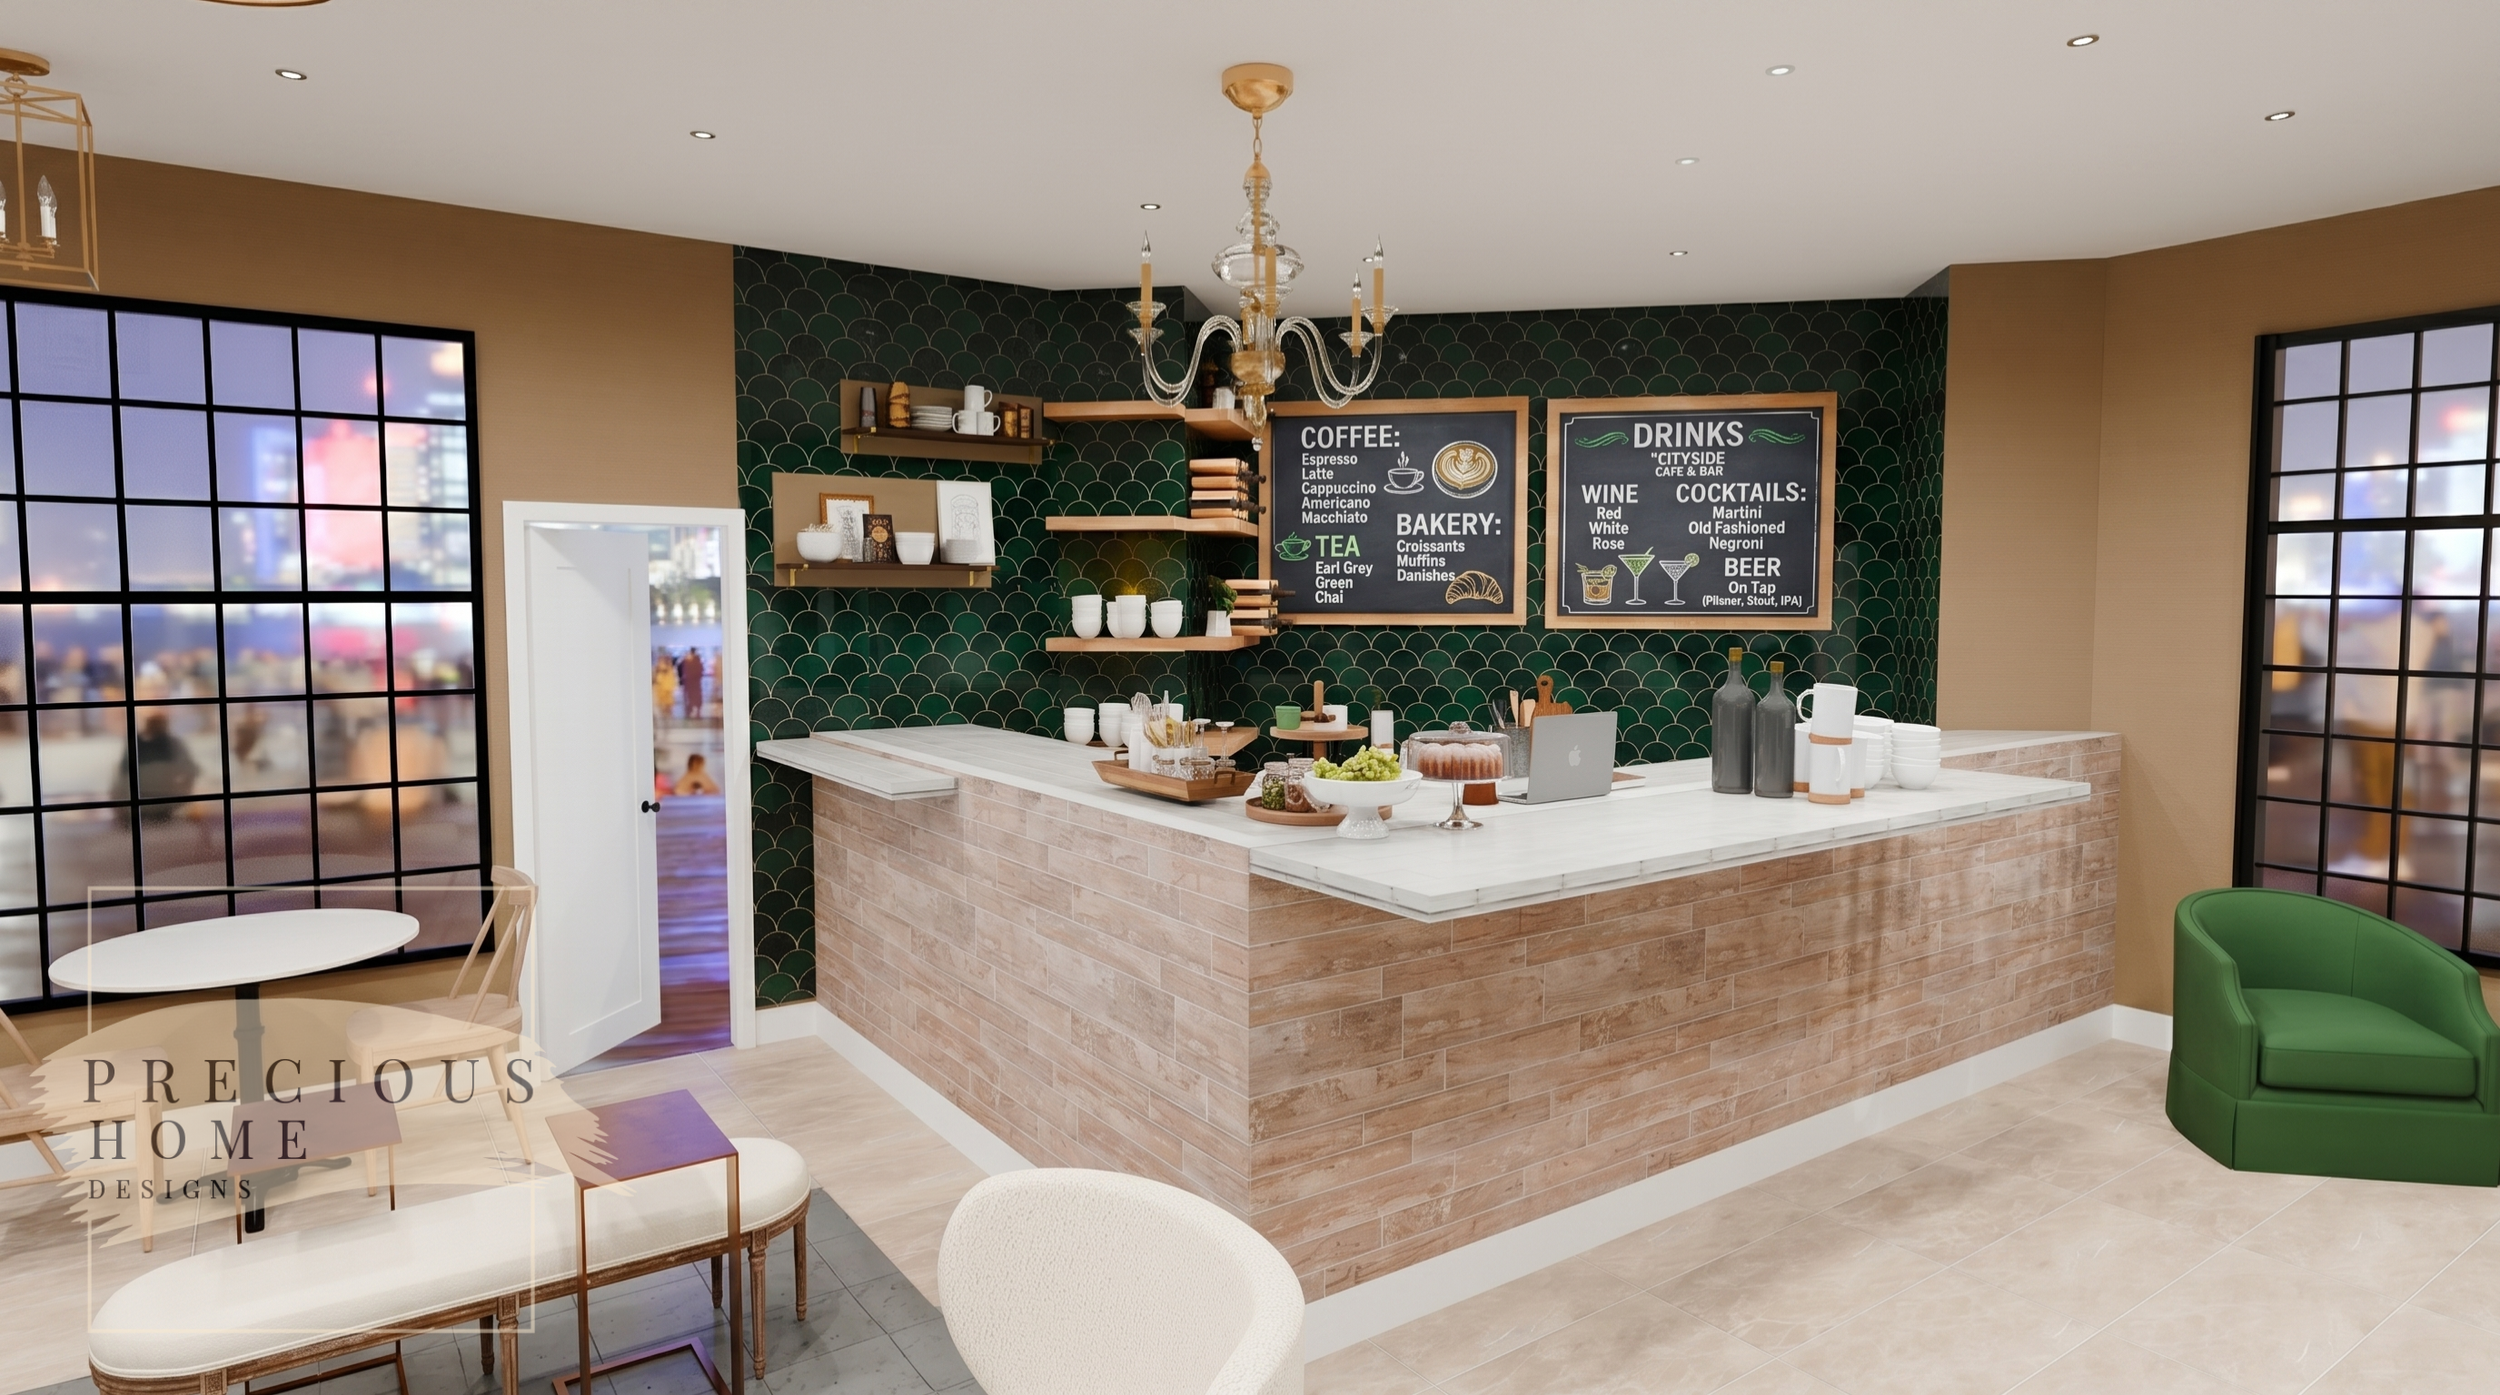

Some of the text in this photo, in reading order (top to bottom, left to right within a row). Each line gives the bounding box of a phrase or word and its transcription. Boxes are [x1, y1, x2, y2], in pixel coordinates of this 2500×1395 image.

[1301, 425, 1400, 449] COFFEE:
[1633, 421, 1743, 448] DRINKS
[1301, 453, 1358, 467] Espresso
[1301, 467, 1334, 480] Latte
[1655, 465, 1724, 477] CAFE & BAR
[1301, 481, 1377, 497] Cappuccino
[1581, 483, 1639, 504] WINE
[1675, 481, 1807, 503] COCKTAILS:
[1301, 496, 1371, 509] Americano
[1301, 510, 1368, 524] Macchiato
[1596, 506, 1622, 520] Red
[1712, 505, 1762, 519] Martini
[1396, 512, 1502, 536] BAKERY:
[1588, 521, 1629, 535] White
[1688, 520, 1786, 535] Old Fashioned
[1315, 534, 1361, 558] TEA
[1396, 539, 1465, 553] Croissants
[1592, 536, 1625, 550] Rose
[1709, 536, 1764, 552] Negroni
[1397, 554, 1446, 567] Muffins
[1724, 557, 1781, 577] BEER
[1315, 561, 1374, 578] Earl Grey
[1397, 568, 1456, 582] Danishes
[1315, 576, 1354, 589] Green
[1728, 580, 1776, 597] On Tap
[1315, 590, 1344, 604] Chai
[1701, 594, 1803, 607] (Pilsner, Stout, IPA)
